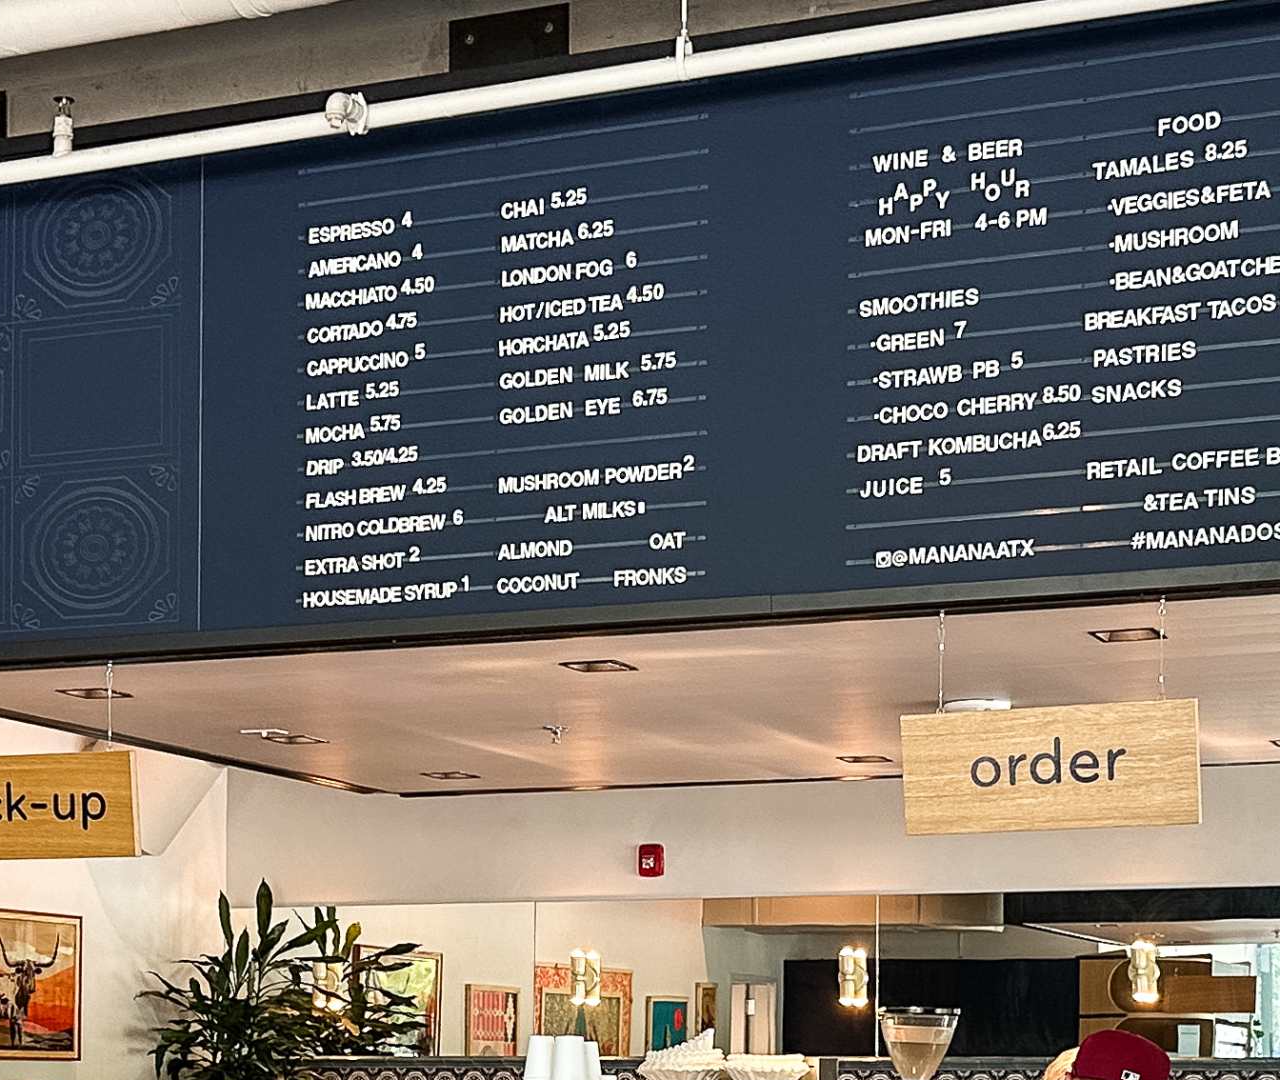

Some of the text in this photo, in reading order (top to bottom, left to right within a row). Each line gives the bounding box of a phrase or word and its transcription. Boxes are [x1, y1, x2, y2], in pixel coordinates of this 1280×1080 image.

[1158, 111, 1222, 137] FOOD
[872, 138, 1023, 173] WINE & BEER
[1092, 139, 1248, 181] TAMALES 8.25
[500, 187, 587, 220] CHAI 5.25
[878, 168, 1030, 216] HAPPY HOUR
[308, 211, 413, 245] ESPRESSO 4
[501, 219, 614, 253] MATCHA 6.25
[865, 207, 1047, 247] MON-FRI 4-6 PM
[308, 243, 423, 278] AMERICANO 4
[501, 251, 637, 288] LONDON FOG 6
[305, 275, 435, 310] MACCHIATO 4.50
[499, 283, 665, 323] HOT/ICED TEA 4.50
[859, 287, 979, 318] SMOOTHIES
[306, 311, 418, 344] CORTADO 4.75
[1084, 302, 1202, 331] BREAKFAST
[1206, 293, 1277, 320] TACOS
[498, 320, 631, 357] HORCHATA 5.25
[953, 320, 967, 339] 7
[306, 342, 426, 377] CAPPUCCINO 5
[499, 351, 677, 390] GOLDEN MILK 5.75
[973, 359, 1000, 379] PB
[1010, 350, 1024, 369] 5
[1093, 340, 1197, 368] PASTRIES
[306, 380, 400, 411] LATTE 5.25
[499, 387, 668, 425] GOLDEN EYE 6.75
[956, 392, 1038, 417] CHERRY
[1042, 384, 1082, 404] 8.50
[1091, 378, 1182, 404] SNACKS
[305, 414, 401, 444] MOCHA 5.75
[857, 420, 1081, 463] DRAFT KOMBUCHA 6.25
[306, 445, 418, 476] DRIP 3.50/4.25
[498, 454, 695, 494] MUSHROOM POWDER 2
[1086, 457, 1163, 481] RETAIL
[1171, 447, 1260, 471] COFFEE
[412, 476, 447, 495] 4.25
[859, 468, 952, 498] JUICE 5
[1143, 486, 1256, 512] &TEA TINS
[305, 509, 464, 542] NITRO COLDBREW 6
[544, 500, 636, 524] ALT MILKS
[497, 539, 573, 561] ALMOND
[649, 531, 686, 550] OAT
[304, 546, 421, 576] EXTRA SHOT 2
[613, 566, 687, 587] FRONKS
[303, 575, 469, 608] HOUSEMADE SYRUP 1
[496, 572, 580, 594] COCONUT
[970, 736, 1126, 789] order
